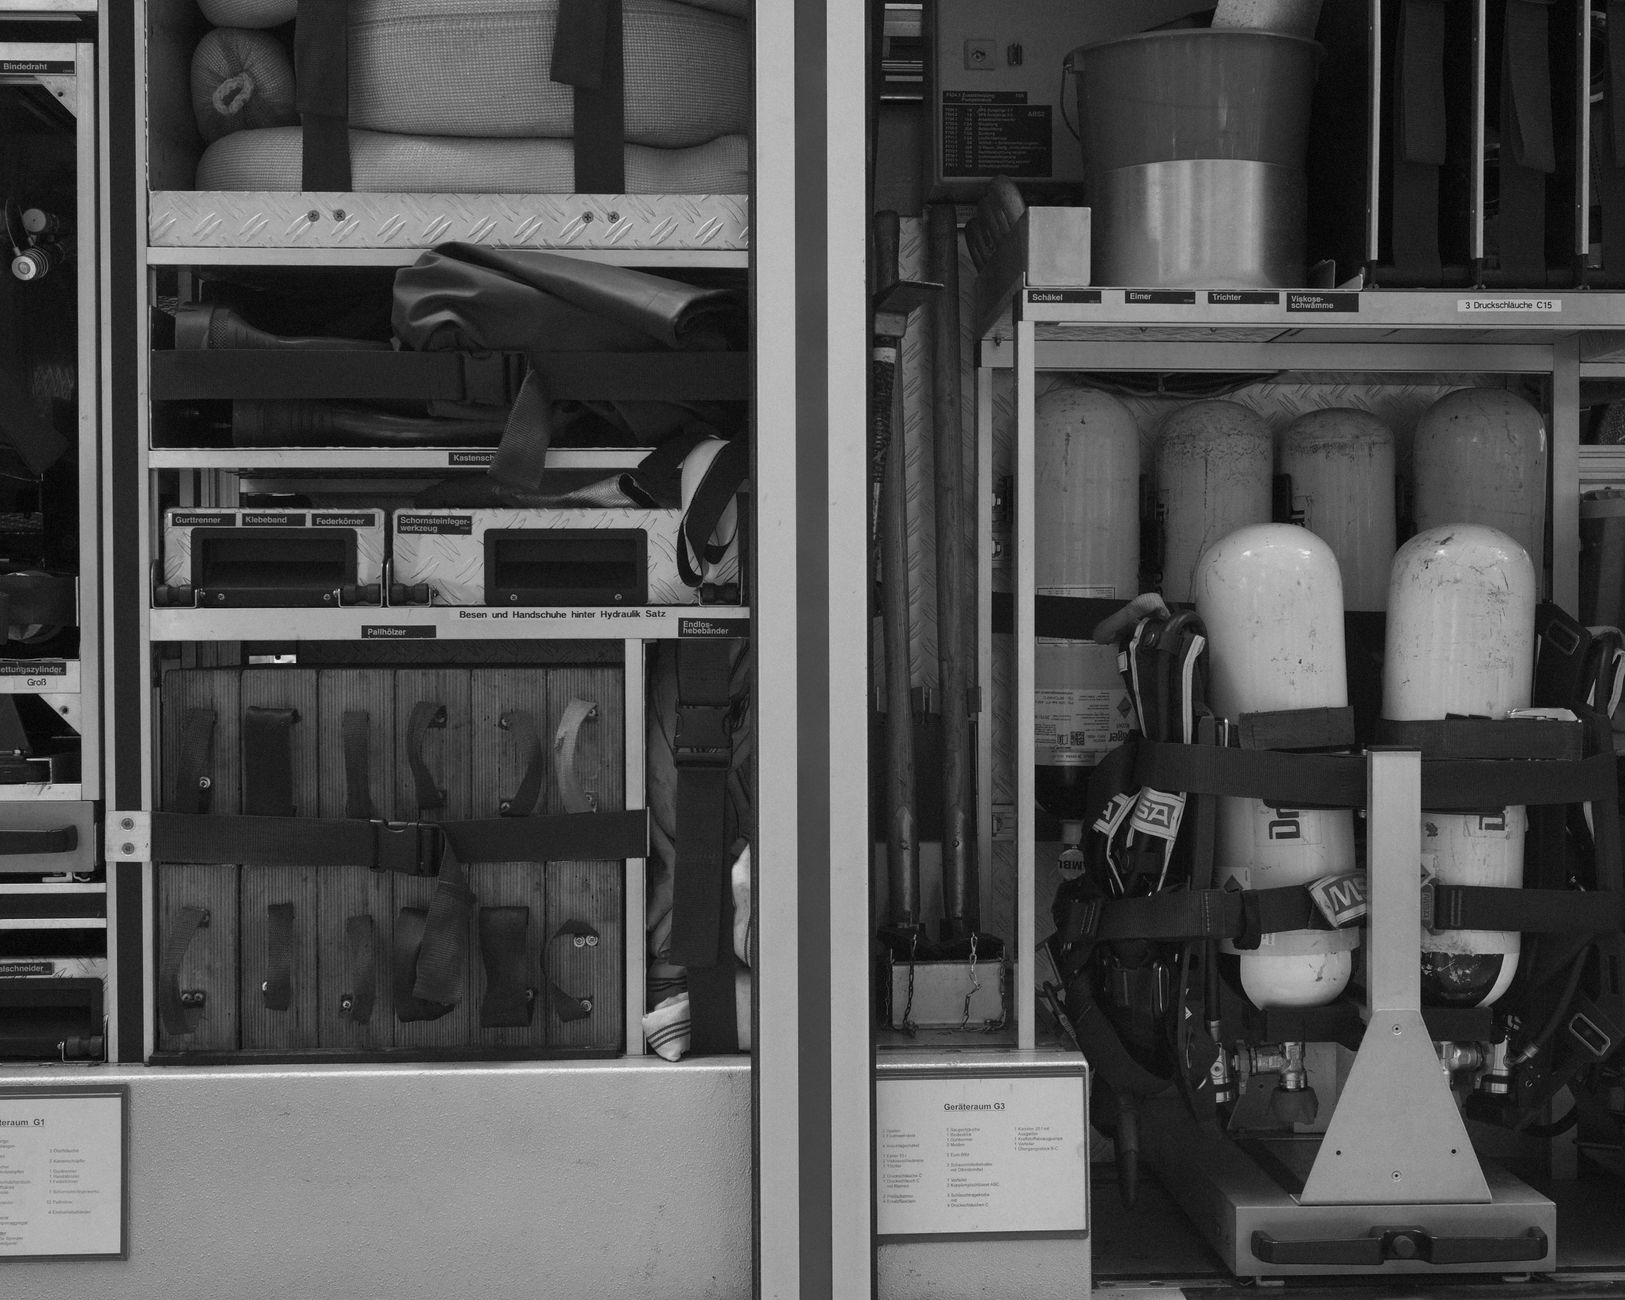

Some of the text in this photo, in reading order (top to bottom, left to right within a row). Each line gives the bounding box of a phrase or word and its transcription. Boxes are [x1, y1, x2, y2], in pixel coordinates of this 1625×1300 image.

[3, 62, 48, 71] Bindedraht
[1032, 292, 1063, 301] Schäkel
[1129, 292, 1152, 300] Eimer
[1212, 293, 1242, 301] Trichter
[1291, 295, 1324, 303] Viskose-
[1291, 301, 1334, 309] schwämme
[1465, 301, 1471, 309] 3
[1473, 300, 1533, 309] Druckschläuche
[453, 454, 496, 462] Kastensch
[175, 515, 222, 524] Gurttrenner
[245, 515, 288, 524] Klebeband
[316, 516, 366, 525] Federkörner
[400, 516, 470, 526] Schornsteinfeger-
[400, 525, 438, 533] werkzeug
[459, 610, 667, 620] Besen und Handschuhe hinter Hydraulik Satz
[683, 620, 713, 628] Endlos-
[367, 627, 407, 636] Pallhölzer
[683, 627, 729, 635] hebebänder
[0, 666, 62, 675] ettungszylinder
[27, 678, 47, 687] Groß
[0, 964, 45, 973] alschneider
[943, 1102, 1006, 1112] Geräteraum G3
[33, 1118, 45, 1126] G1
